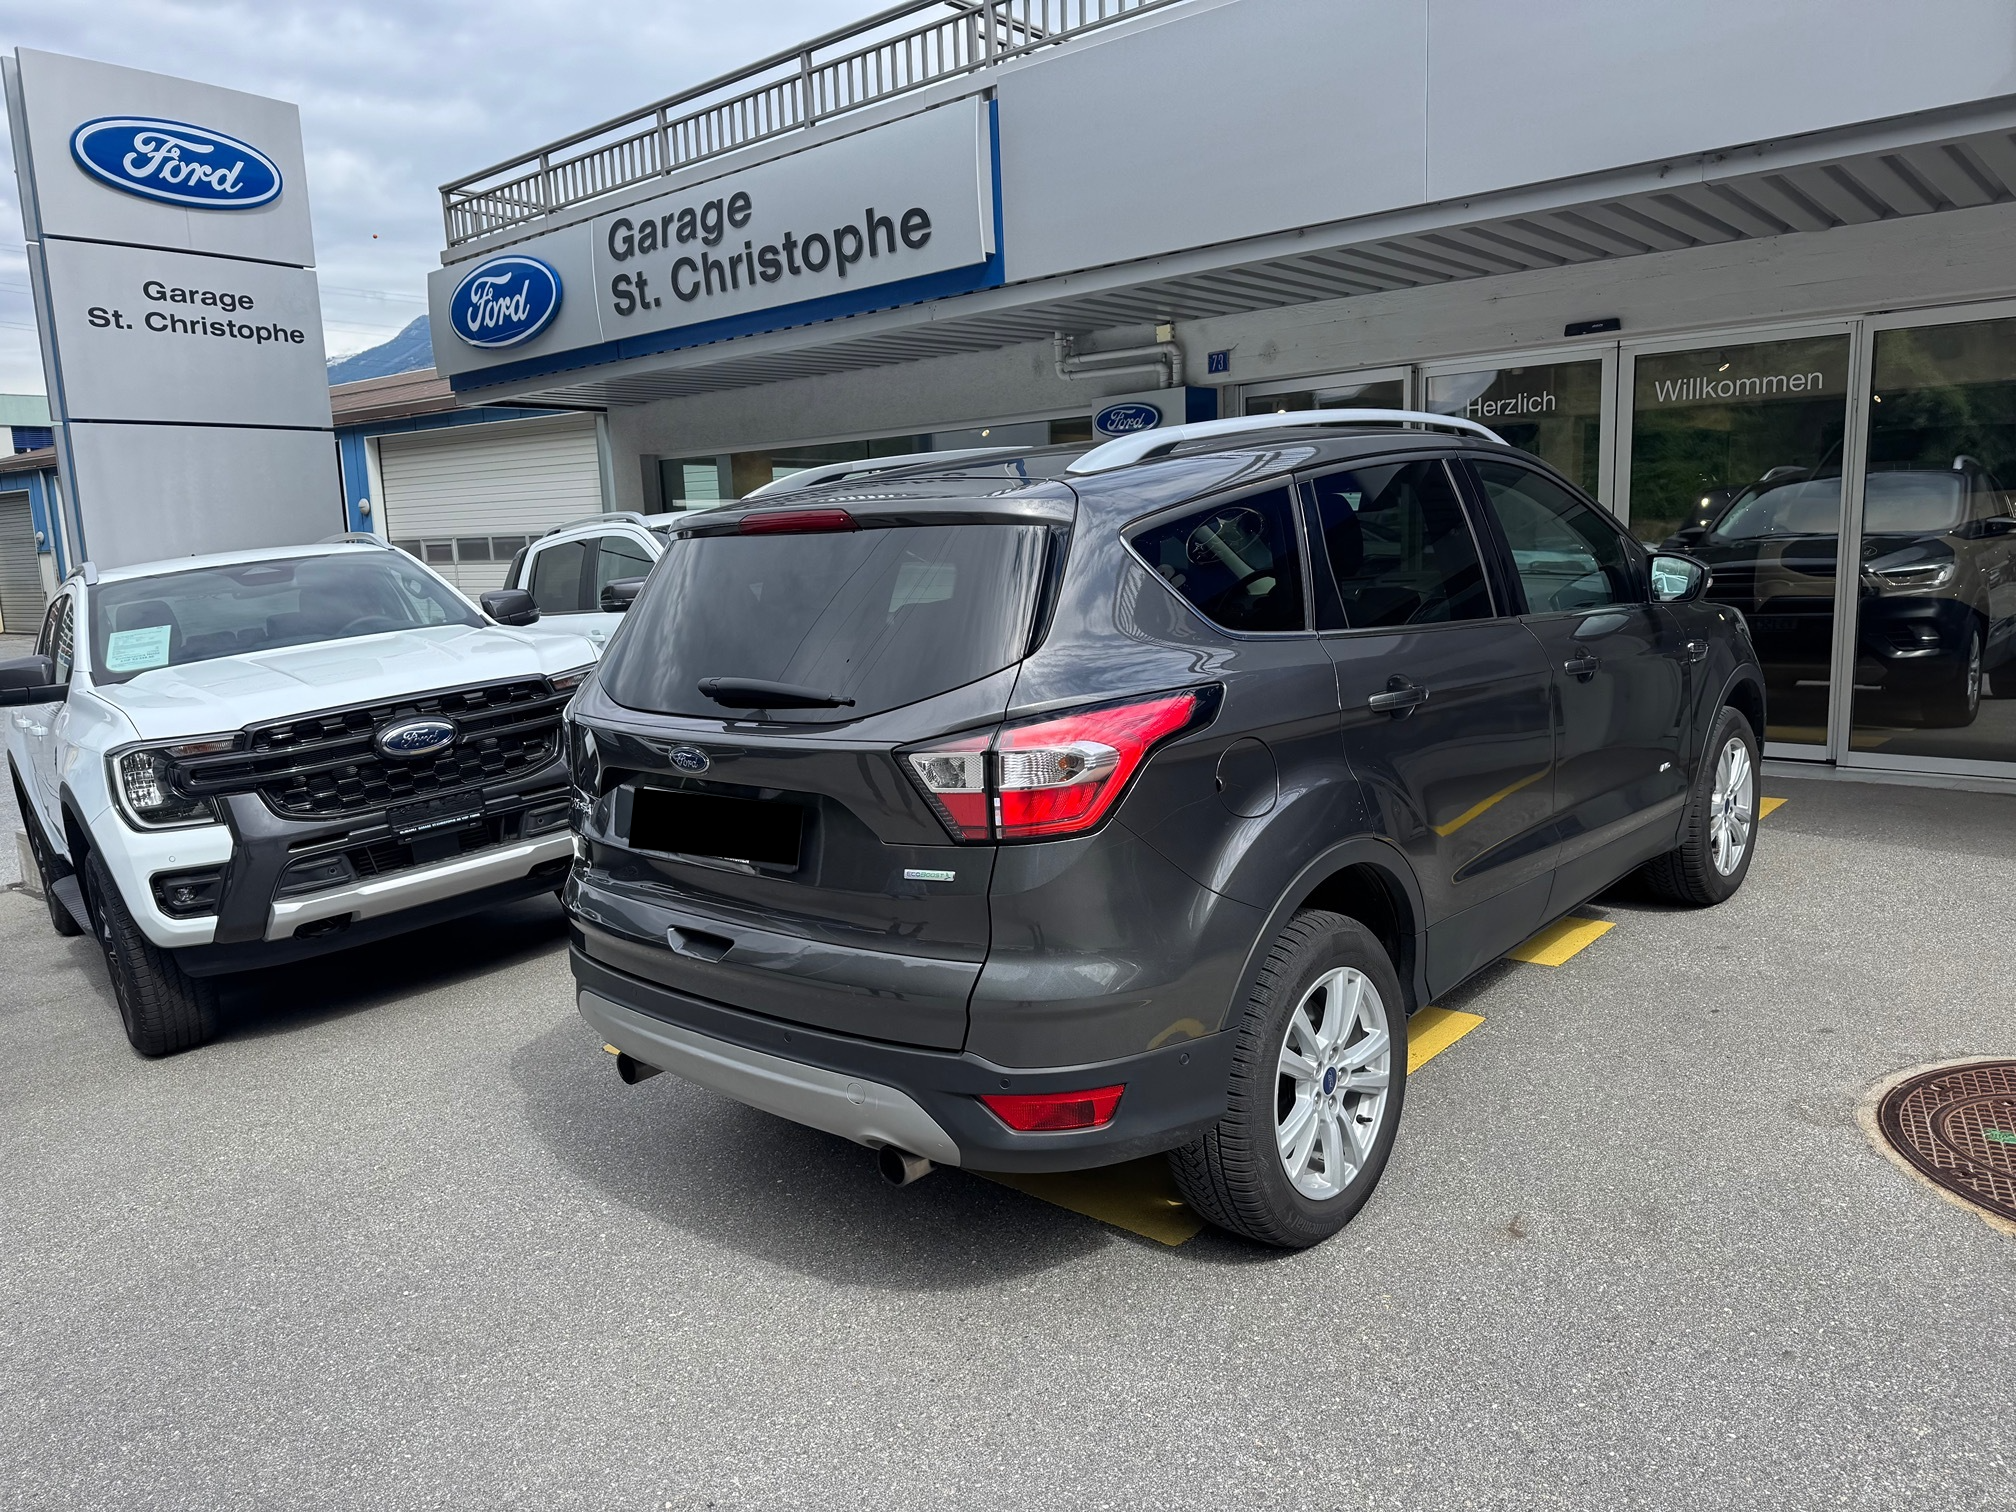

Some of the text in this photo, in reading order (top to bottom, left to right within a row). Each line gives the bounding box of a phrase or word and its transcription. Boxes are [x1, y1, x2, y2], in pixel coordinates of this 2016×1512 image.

[123, 131, 245, 194] Ford
[608, 190, 753, 262] Garage
[611, 205, 933, 317] St. Christophe
[142, 280, 255, 313] Garage
[466, 271, 531, 333] Ford
[87, 306, 306, 345] St. Christophe
[1211, 354, 1225, 371] 73
[1654, 370, 1824, 403] Willkommen
[1106, 408, 1146, 431] Ford
[1465, 390, 1557, 419] Herzlich
[401, 728, 440, 749] Ford
[675, 751, 699, 769] Ford
